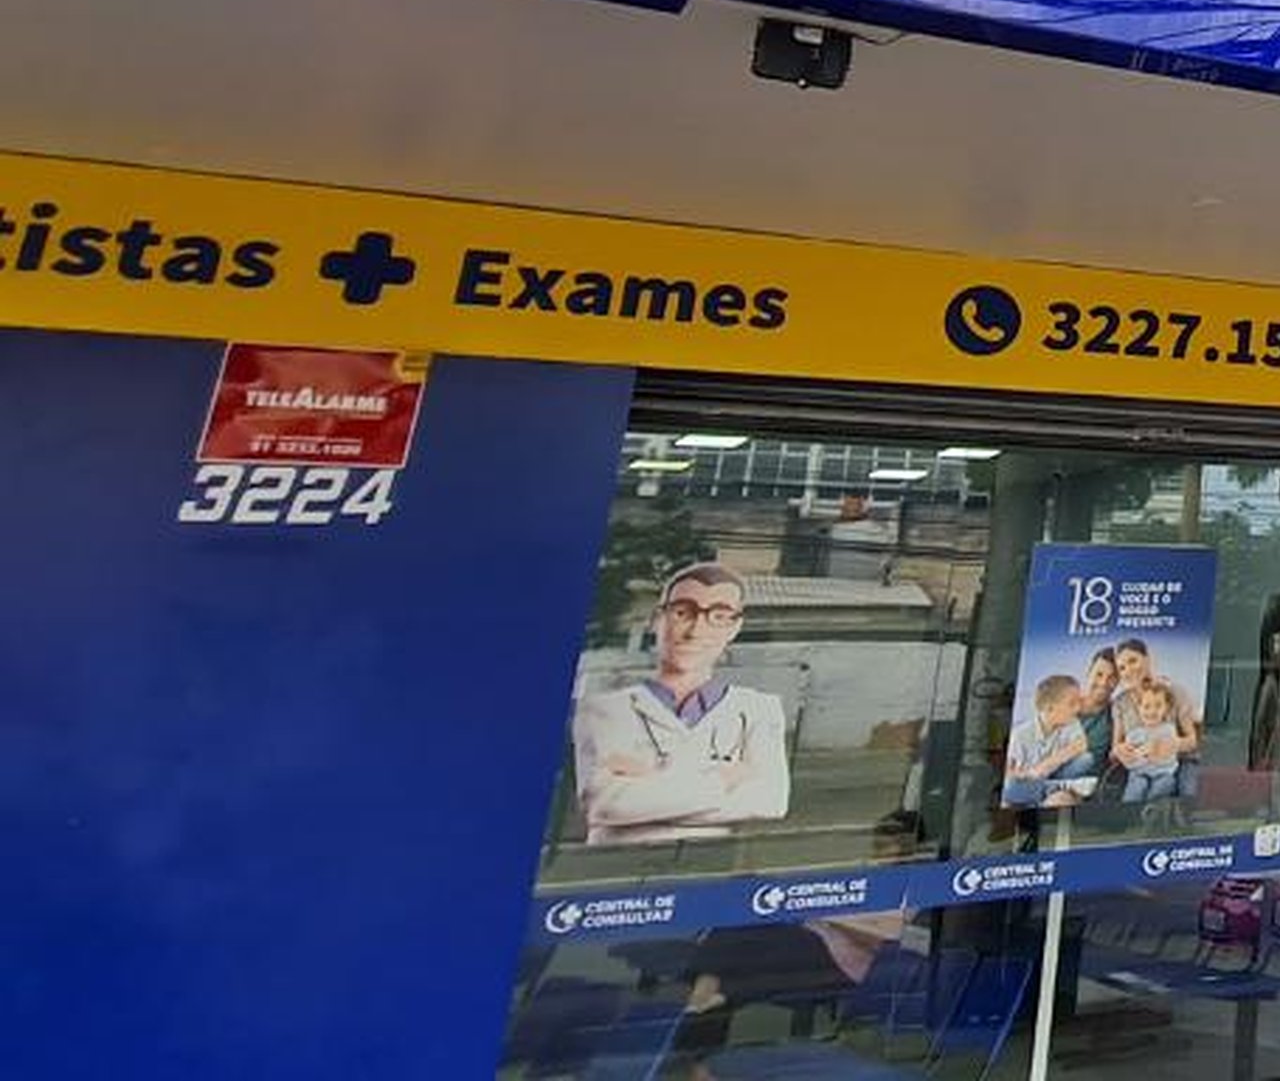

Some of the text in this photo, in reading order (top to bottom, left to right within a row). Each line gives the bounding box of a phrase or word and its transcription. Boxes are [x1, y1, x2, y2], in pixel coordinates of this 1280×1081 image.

[454, 248, 790, 331] Exames
[179, 465, 397, 525] 3224
[1067, 576, 1113, 635] 18
